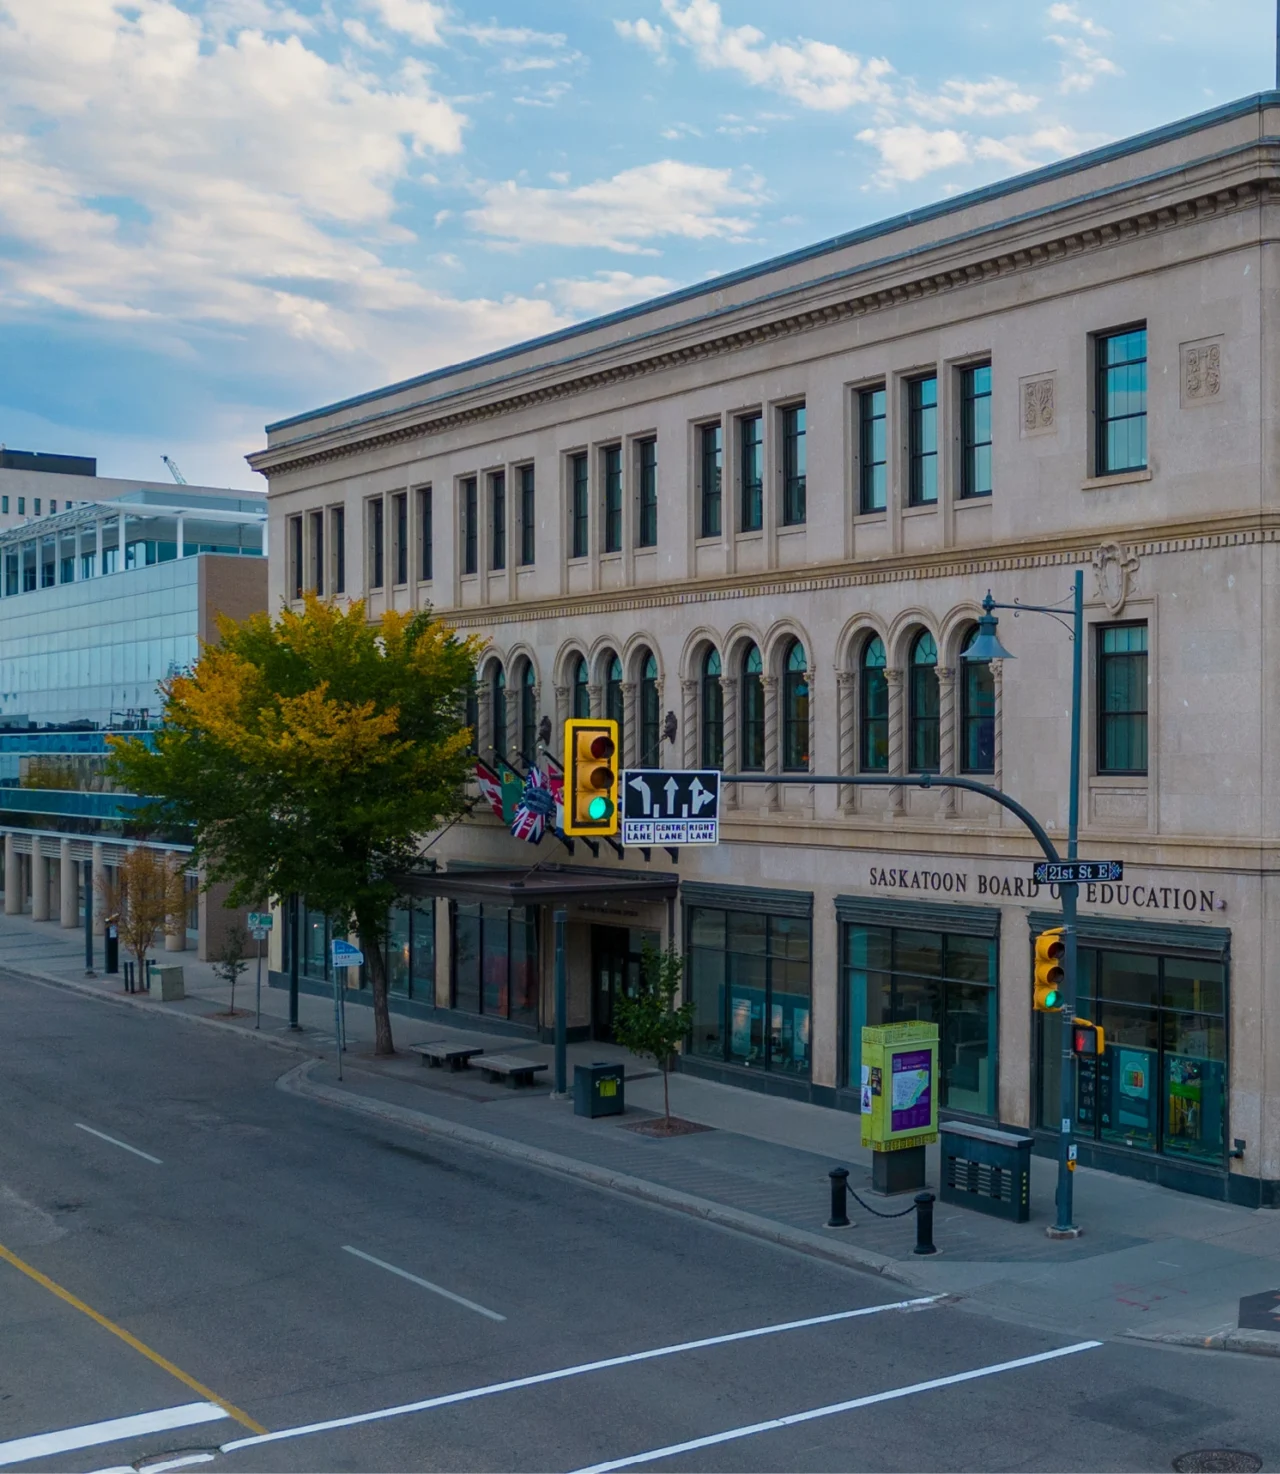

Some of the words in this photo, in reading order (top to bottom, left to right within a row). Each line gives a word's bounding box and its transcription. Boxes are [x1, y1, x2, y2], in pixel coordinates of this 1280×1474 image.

[689, 823, 714, 831] RIGHT
[627, 833, 652, 841] LANE
[690, 832, 714, 840] LANE
[1048, 866, 1073, 879] 21st
[1079, 865, 1092, 878] St
[1098, 864, 1108, 877] E
[869, 867, 967, 892] SASKATOON
[977, 874, 1040, 898] BOARD
[1086, 883, 1215, 912] EDUCATION
